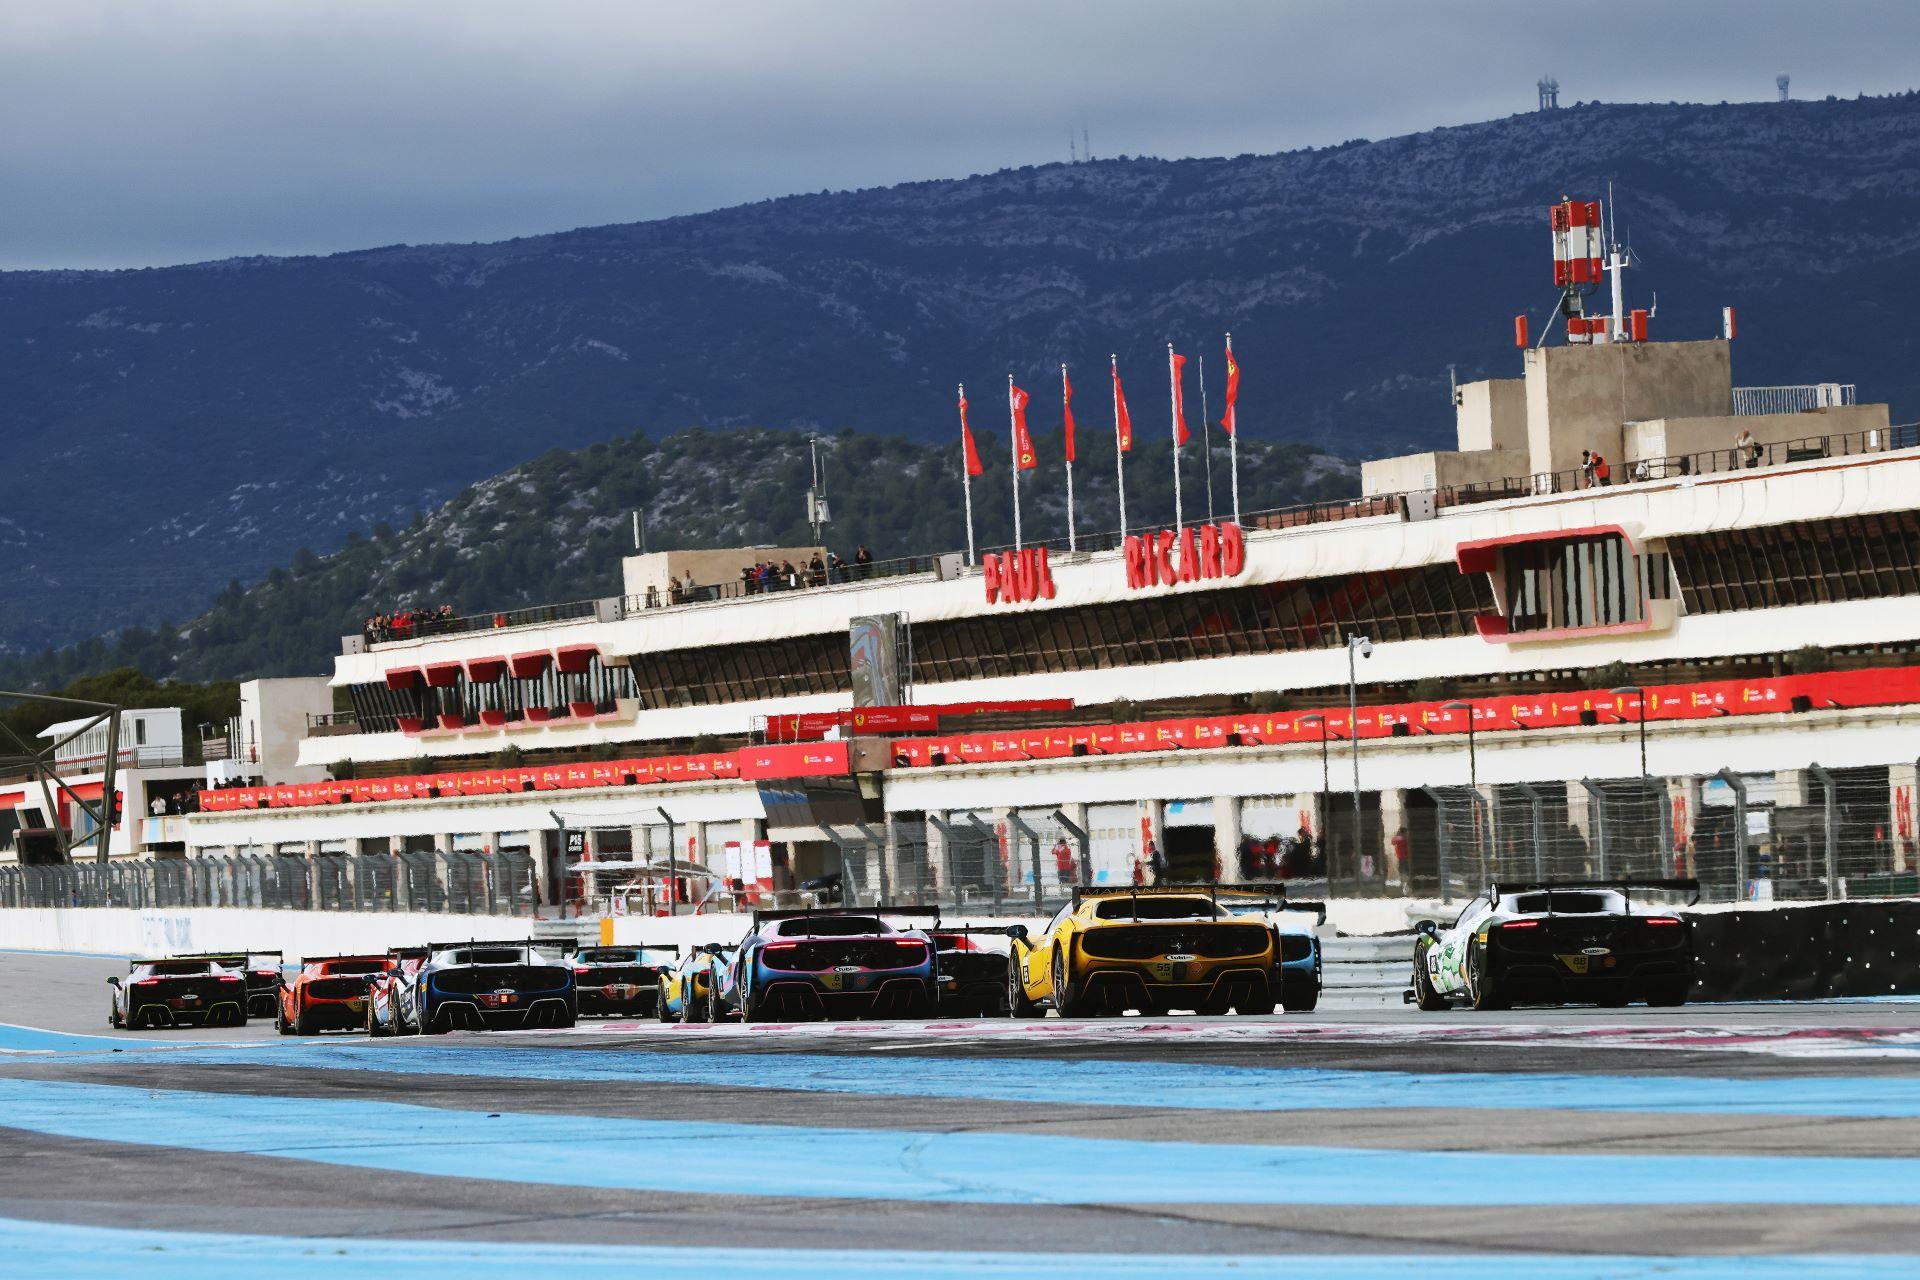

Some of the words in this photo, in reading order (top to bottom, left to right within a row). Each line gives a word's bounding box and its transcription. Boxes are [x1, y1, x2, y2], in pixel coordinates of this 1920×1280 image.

[983, 546, 1055, 604] PAUL
[1124, 521, 1243, 589] RICARD
[1156, 963, 1170, 971] 55
[834, 974, 840, 982] 6
